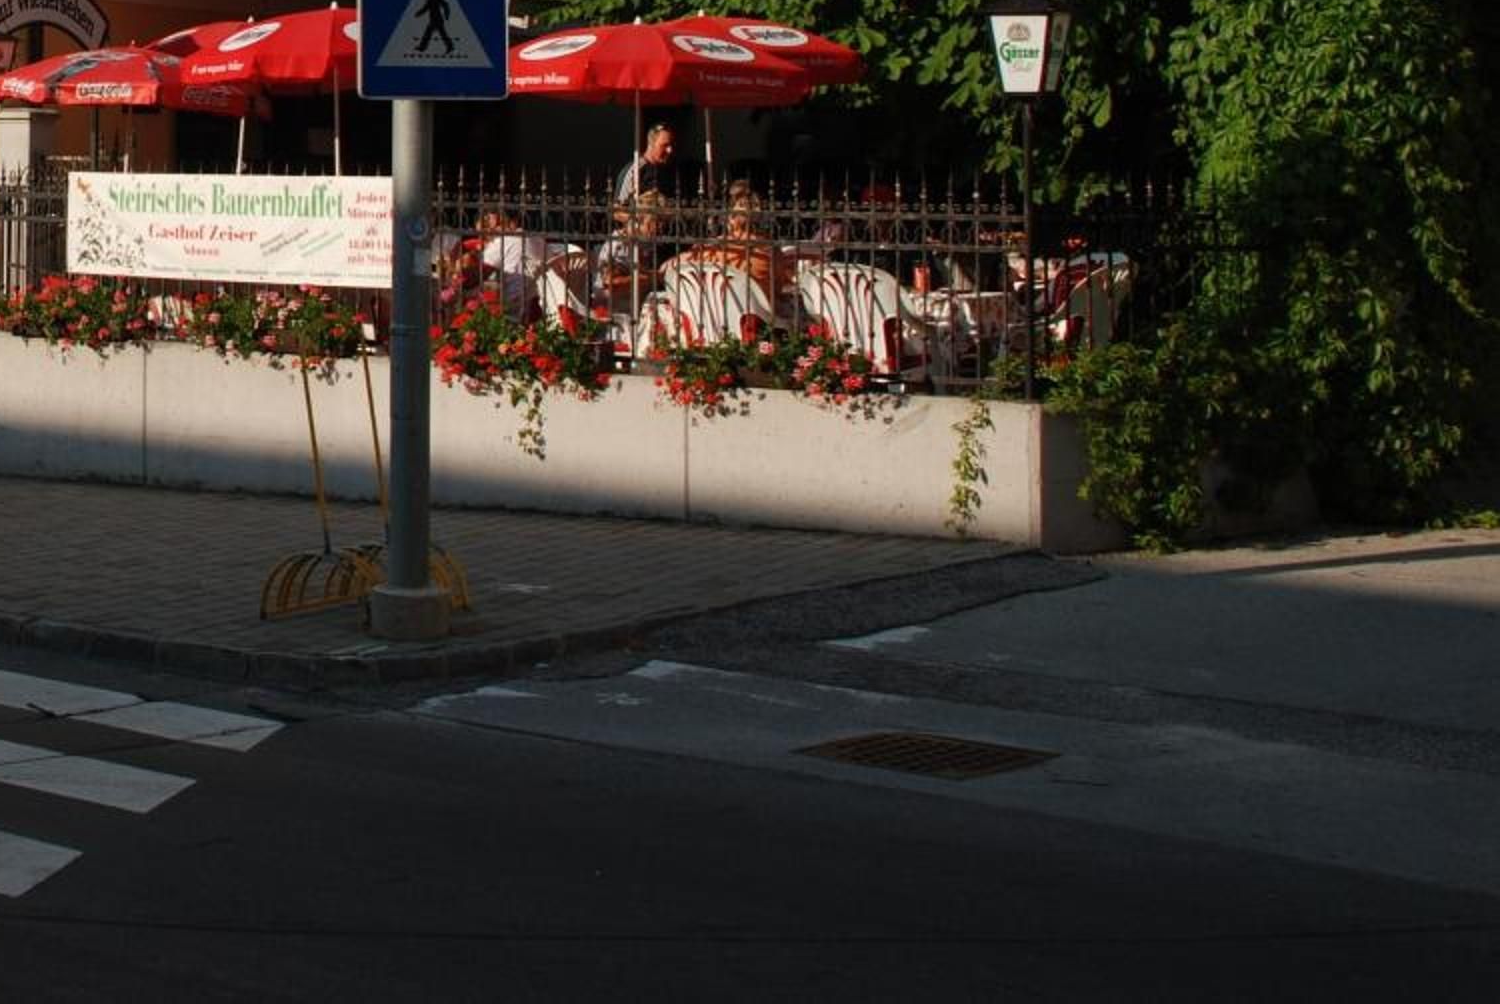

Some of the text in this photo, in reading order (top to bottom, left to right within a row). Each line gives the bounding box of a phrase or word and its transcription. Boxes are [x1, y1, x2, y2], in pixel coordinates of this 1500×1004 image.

[108, 181, 343, 218] Steirisches Bauernbuffet
[347, 208, 393, 220] Mittwoc
[148, 223, 257, 242] Gasthof Zeiser
